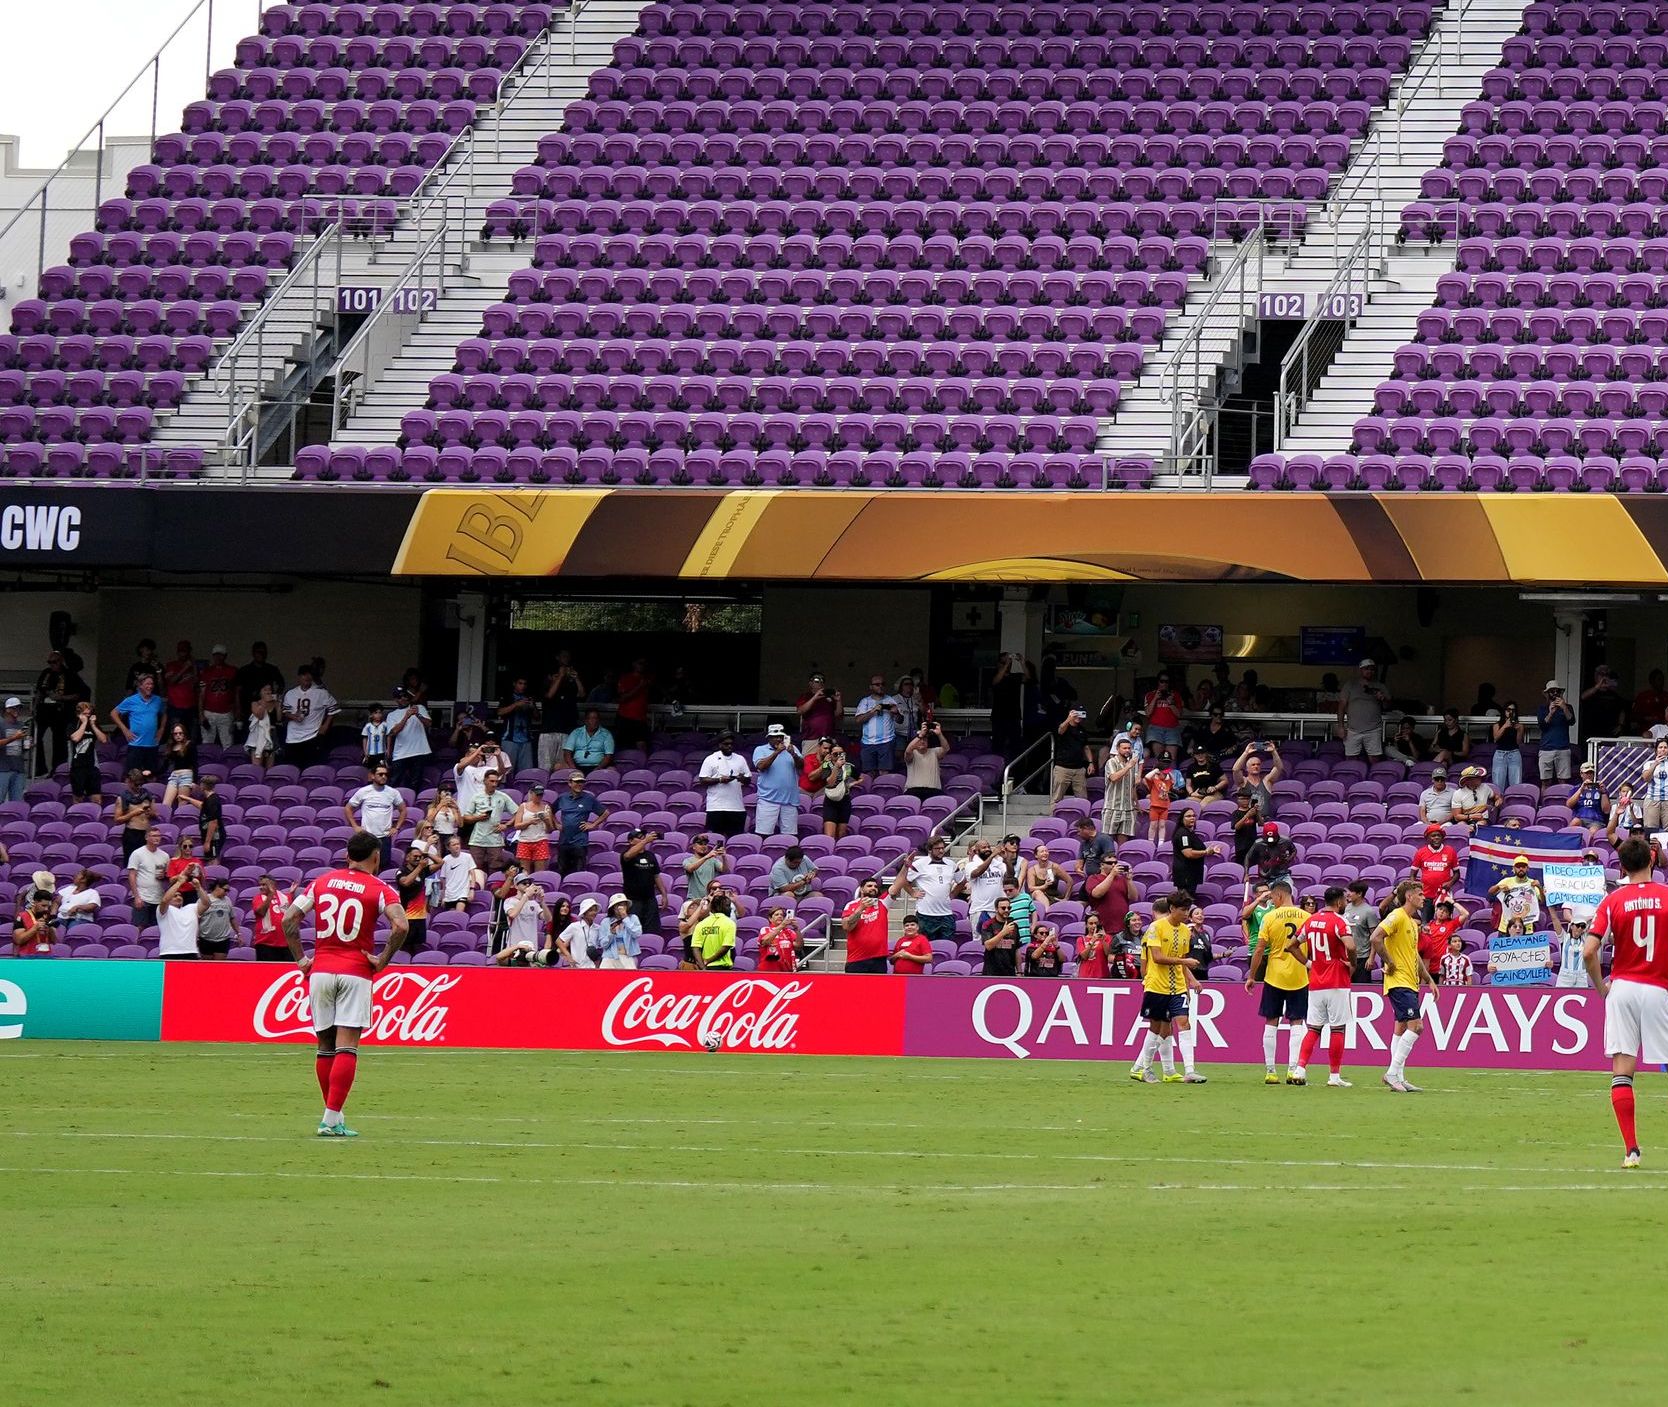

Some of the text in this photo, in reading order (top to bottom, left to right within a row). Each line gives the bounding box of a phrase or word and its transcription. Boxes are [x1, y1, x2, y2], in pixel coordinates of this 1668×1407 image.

[341, 289, 381, 311] 101
[1261, 295, 1302, 317] 102
[0, 504, 82, 552] CWC
[1553, 879, 1596, 890] GRACIAS
[317, 893, 364, 942] 30
[1308, 932, 1331, 961] 14
[1633, 915, 1655, 962] 4
[601, 978, 813, 1049] Coca-Cola
